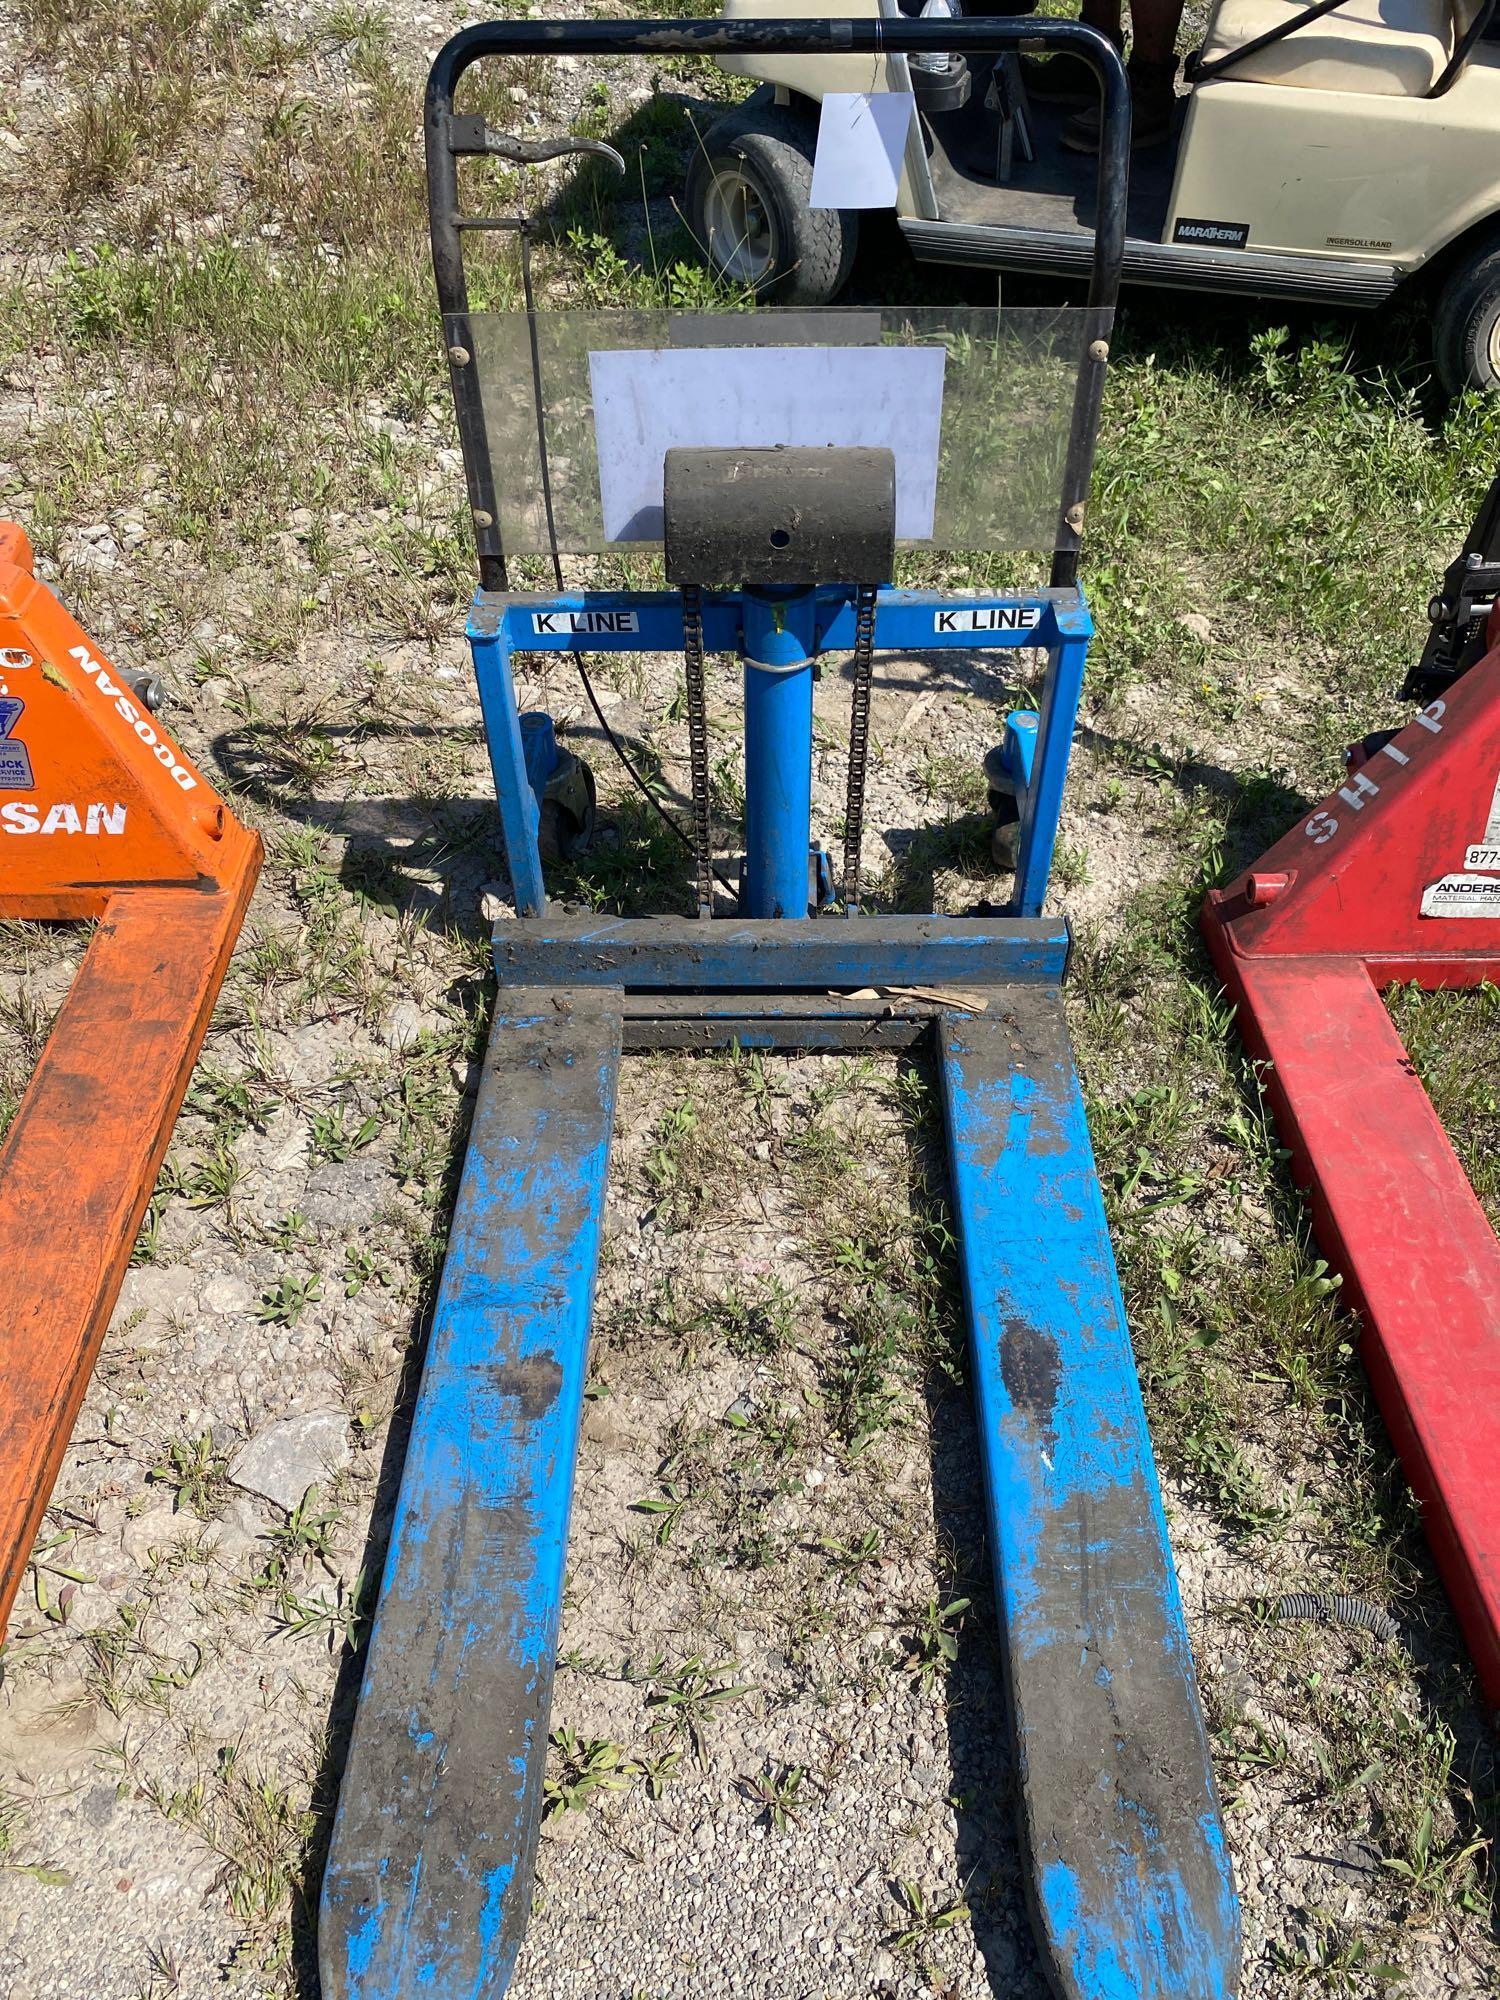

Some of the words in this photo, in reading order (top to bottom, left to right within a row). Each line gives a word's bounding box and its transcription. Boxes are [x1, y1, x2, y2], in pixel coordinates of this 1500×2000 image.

[1178, 225, 1243, 241] MARATHERM
[1326, 237, 1392, 248] INGERSOLL-RAND
[536, 613, 557, 633] K
[569, 612, 633, 633] LINE
[939, 612, 957, 632] K
[971, 608, 1035, 630] LINE
[68, 645, 197, 791] DOOSAN
[1305, 699, 1447, 844] SHIP
[0, 801, 128, 835] SAN
